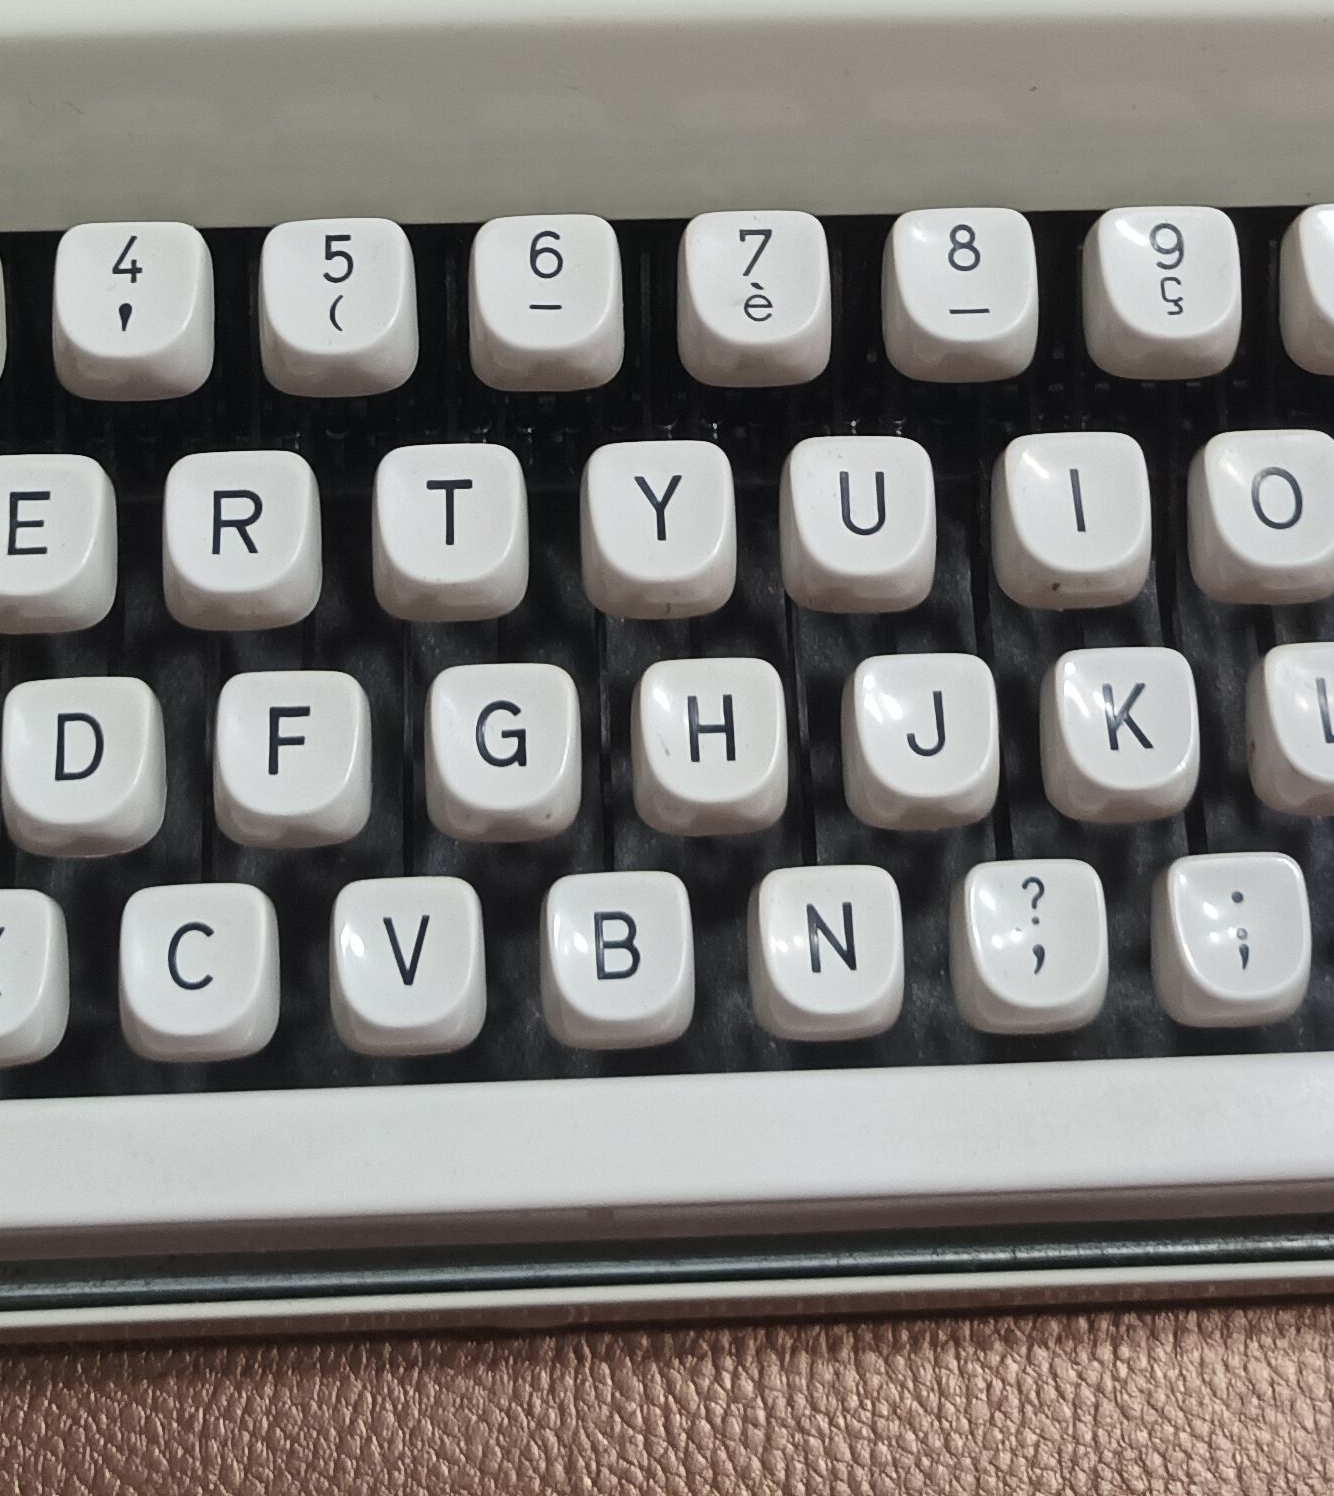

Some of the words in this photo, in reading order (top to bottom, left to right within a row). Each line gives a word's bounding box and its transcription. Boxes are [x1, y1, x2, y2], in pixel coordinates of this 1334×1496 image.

[112, 236, 142, 283] 4
[323, 235, 353, 283] 5
[530, 231, 563, 279] 6
[739, 229, 772, 276] 7
[948, 224, 980, 271] 8
[1150, 223, 1184, 270] 9
[330, 295, 343, 331] (
[744, 282, 773, 322] è
[1160, 277, 1183, 315] ç
[7, 491, 51, 555] E
[212, 490, 263, 555] R
[426, 479, 473, 545] T
[634, 475, 682, 541] Y
[840, 471, 886, 535] U
[1070, 469, 1086, 532] I
[1251, 467, 1303, 529] O
[55, 713, 104, 781] D
[268, 706, 310, 775] F
[476, 700, 527, 767] G
[688, 694, 736, 762] H
[907, 691, 945, 756] J
[1103, 683, 1153, 751] K
[1022, 877, 1044, 925] ?
[168, 922, 214, 990] C
[383, 915, 430, 986] V
[594, 911, 640, 980] B
[807, 902, 857, 973] N
